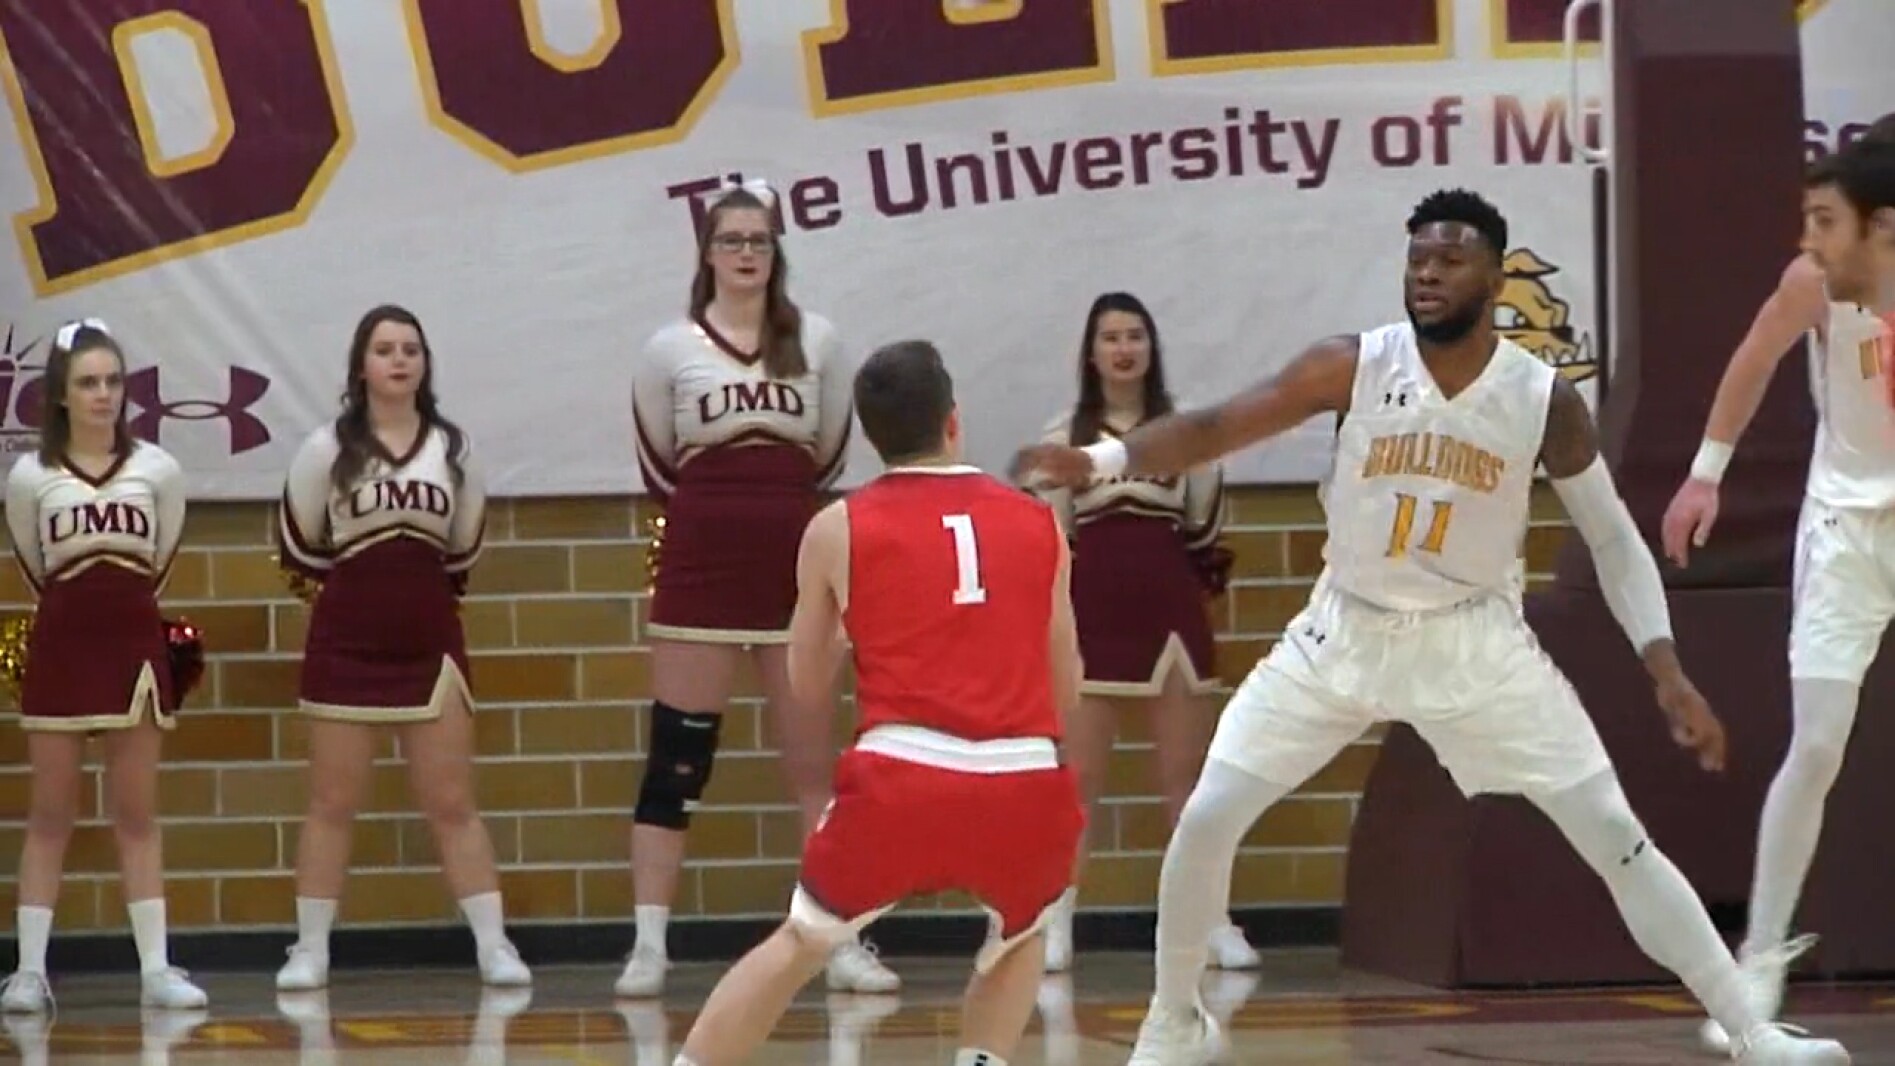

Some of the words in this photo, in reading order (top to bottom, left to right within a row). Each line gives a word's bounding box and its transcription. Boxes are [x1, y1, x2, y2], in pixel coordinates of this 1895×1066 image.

[868, 97, 1340, 218] University
[1370, 95, 1463, 167] of
[698, 381, 805, 424] UMD
[50, 502, 150, 543] UMD
[350, 480, 451, 518] UMD
[1383, 492, 1454, 558] 11
[941, 513, 987, 605] 1
